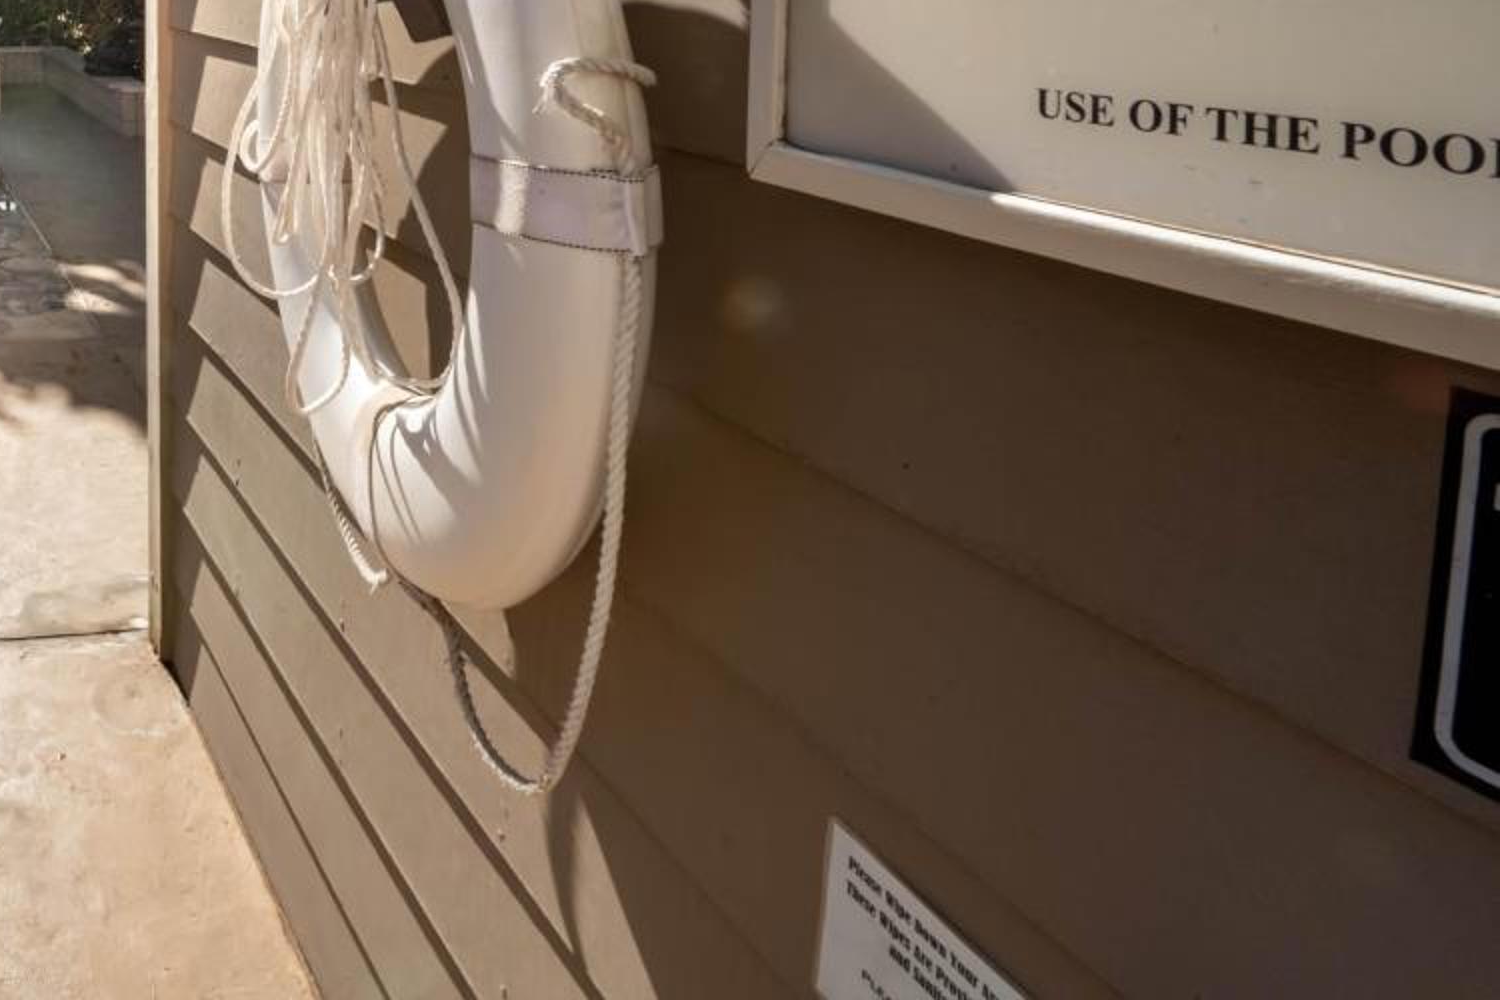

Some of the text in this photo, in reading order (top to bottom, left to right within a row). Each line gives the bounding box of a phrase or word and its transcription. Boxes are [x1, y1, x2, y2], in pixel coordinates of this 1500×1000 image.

[1036, 87, 1115, 127] USE
[1128, 98, 1195, 136] OF
[1205, 106, 1321, 155] THE
